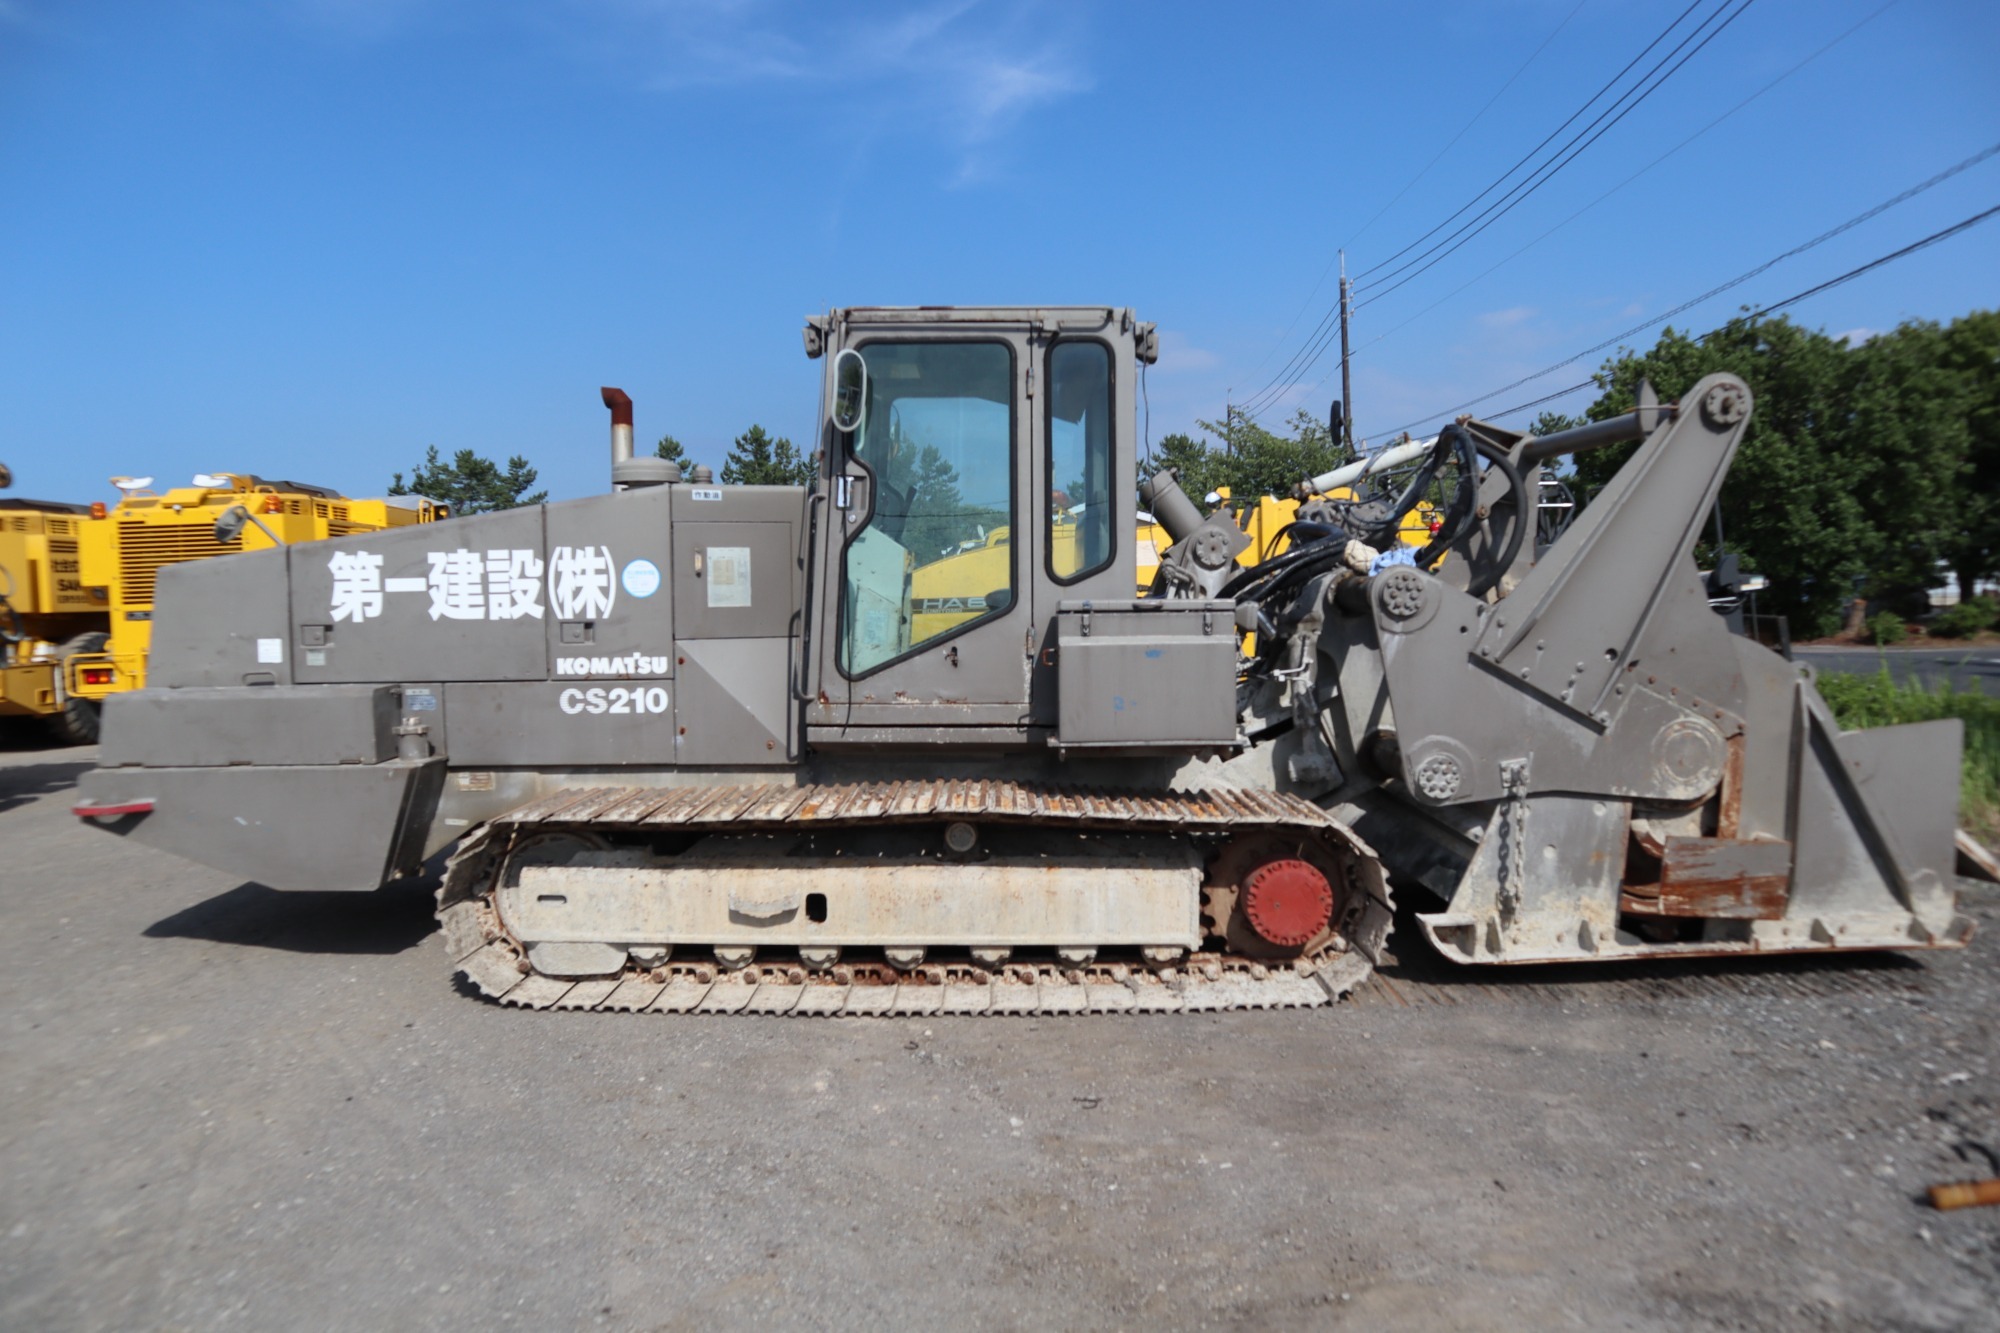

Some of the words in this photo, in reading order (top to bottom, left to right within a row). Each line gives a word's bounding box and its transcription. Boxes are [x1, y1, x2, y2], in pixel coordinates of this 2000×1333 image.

[327, 546, 617, 623] 第一建設(株)
[556, 652, 668, 675] KOMATSU
[559, 687, 669, 715] CS210
